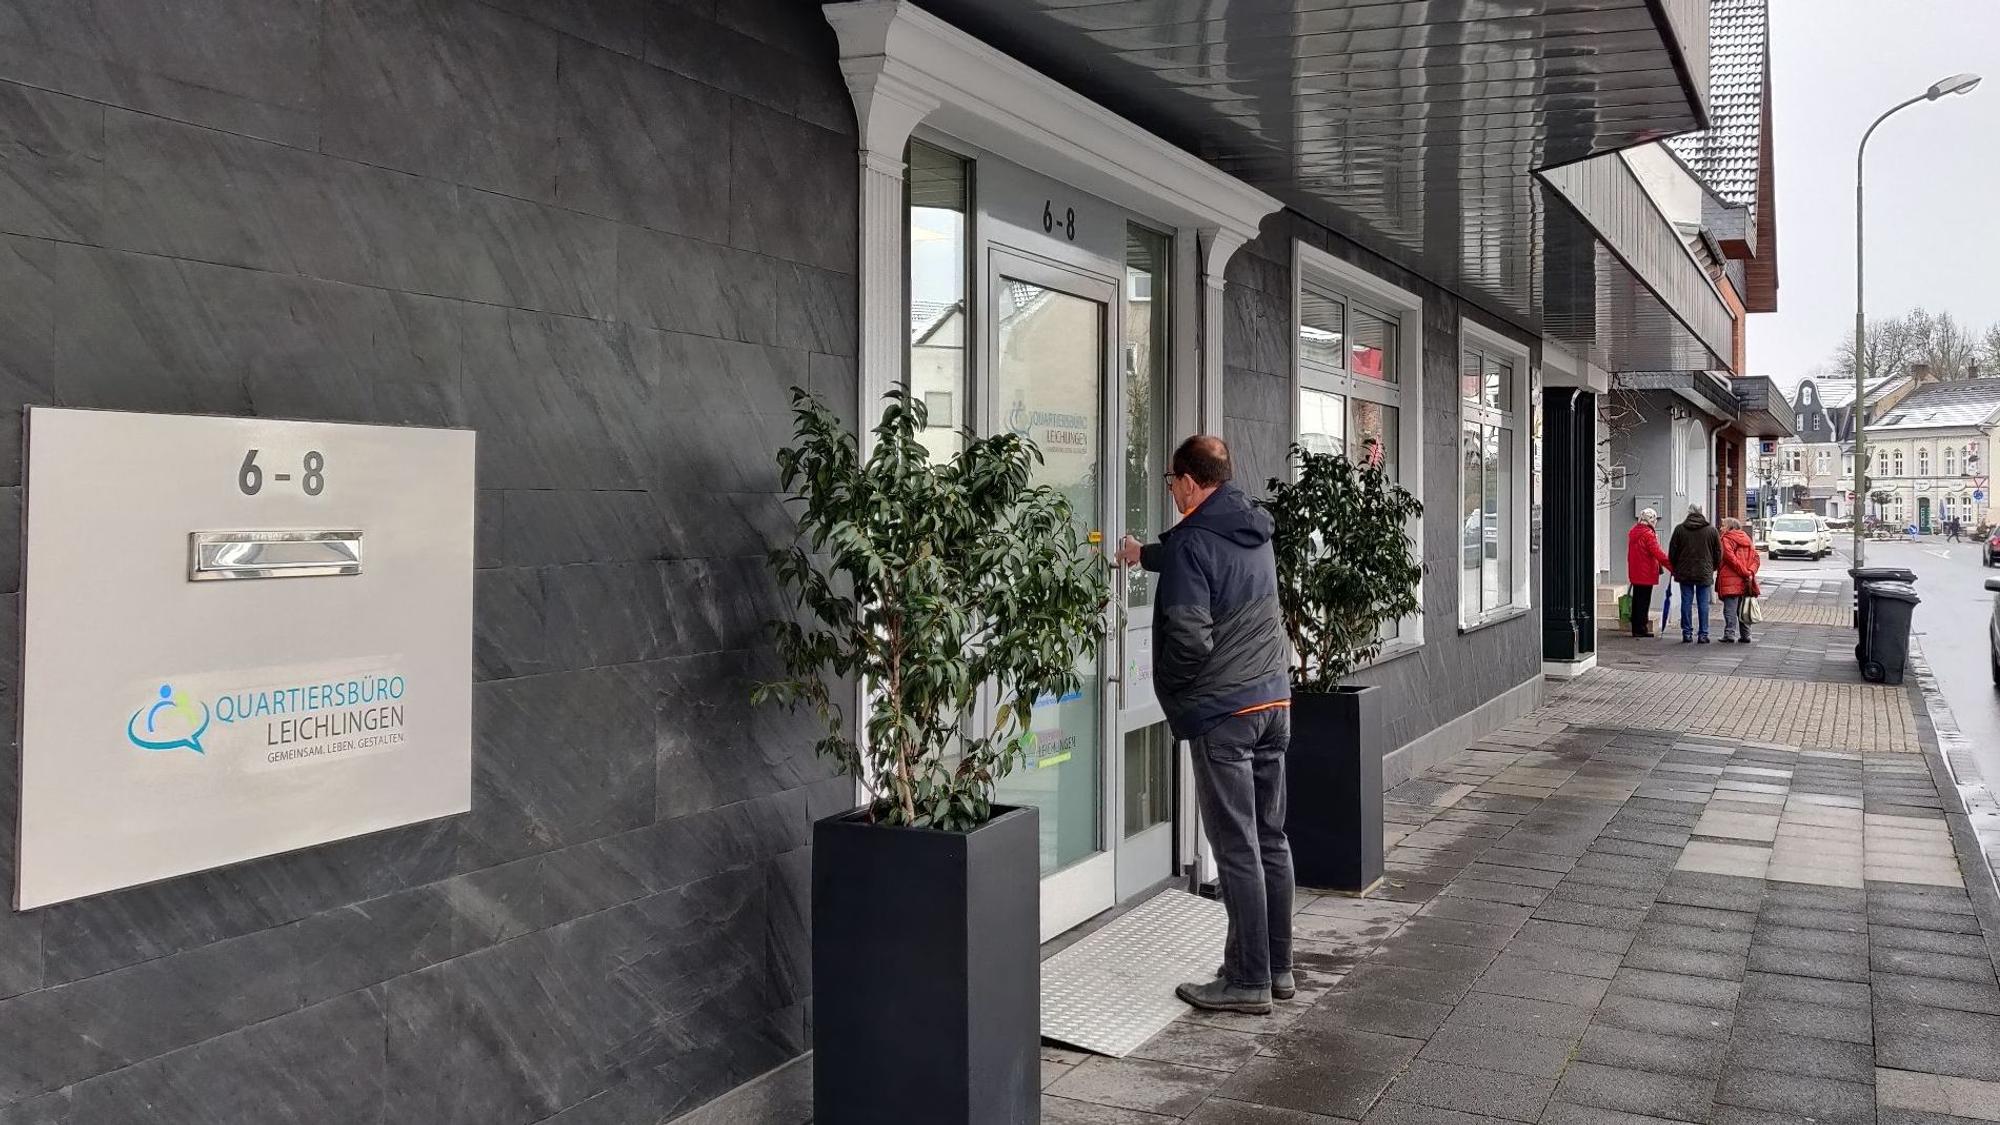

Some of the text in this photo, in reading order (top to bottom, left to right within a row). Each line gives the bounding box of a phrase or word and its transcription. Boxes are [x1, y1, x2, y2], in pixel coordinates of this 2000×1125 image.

[1043, 200, 1075, 241] 6-8
[216, 675, 404, 723] QUARTIERSBÜRO
[267, 705, 404, 746] LEICHLINGEN
[267, 733, 404, 763] GEMEINSAM. LEBEN. GESTALTEN
